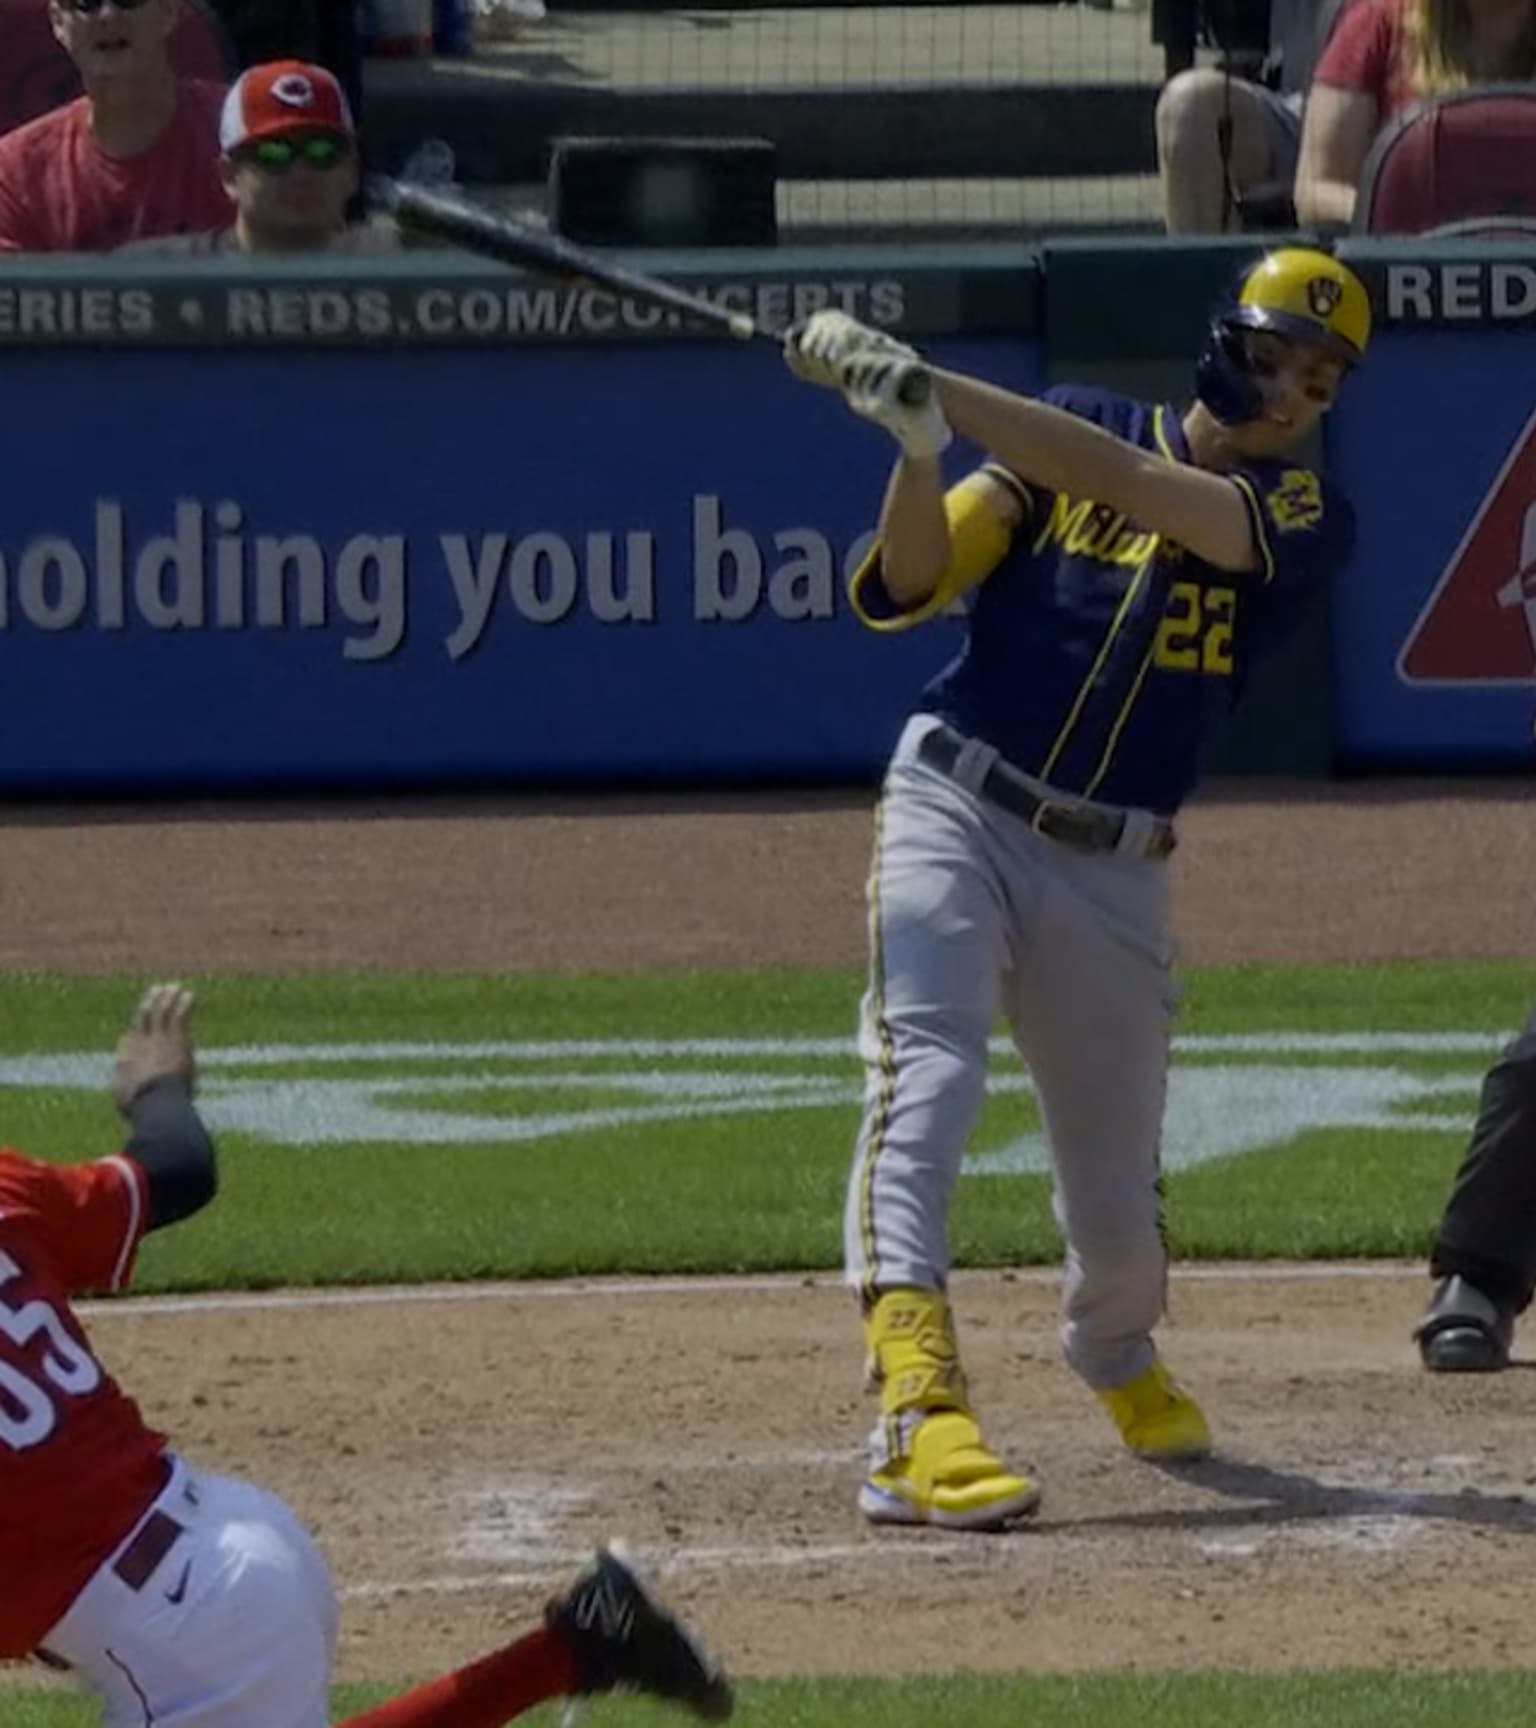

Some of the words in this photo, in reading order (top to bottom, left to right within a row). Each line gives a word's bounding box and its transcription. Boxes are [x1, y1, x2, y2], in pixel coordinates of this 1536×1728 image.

[0, 497, 405, 660] olding
[439, 531, 653, 660] you
[1153, 581, 1237, 676] 22
